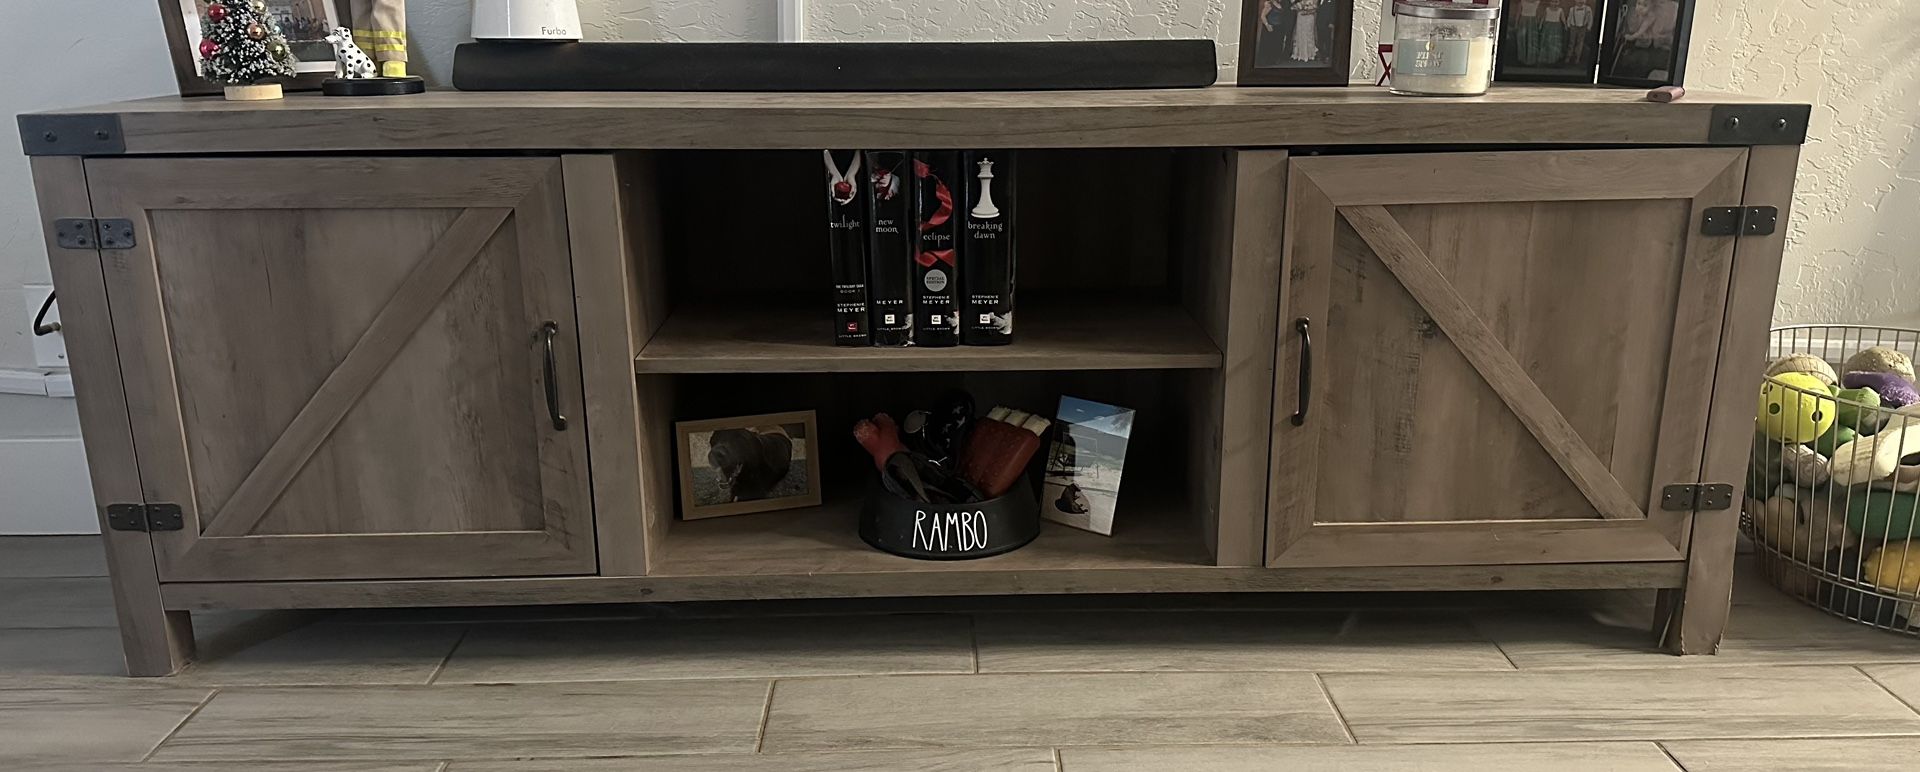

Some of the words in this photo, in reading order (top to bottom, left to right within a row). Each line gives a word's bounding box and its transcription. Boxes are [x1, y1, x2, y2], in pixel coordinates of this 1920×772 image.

[541, 26, 567, 36] Furbo
[830, 214, 861, 231] twilight
[967, 220, 1003, 232] breaking
[875, 226, 899, 234] moon
[973, 230, 996, 239] dawn
[922, 232, 951, 248] eclipse
[912, 510, 988, 552] RAMBO
